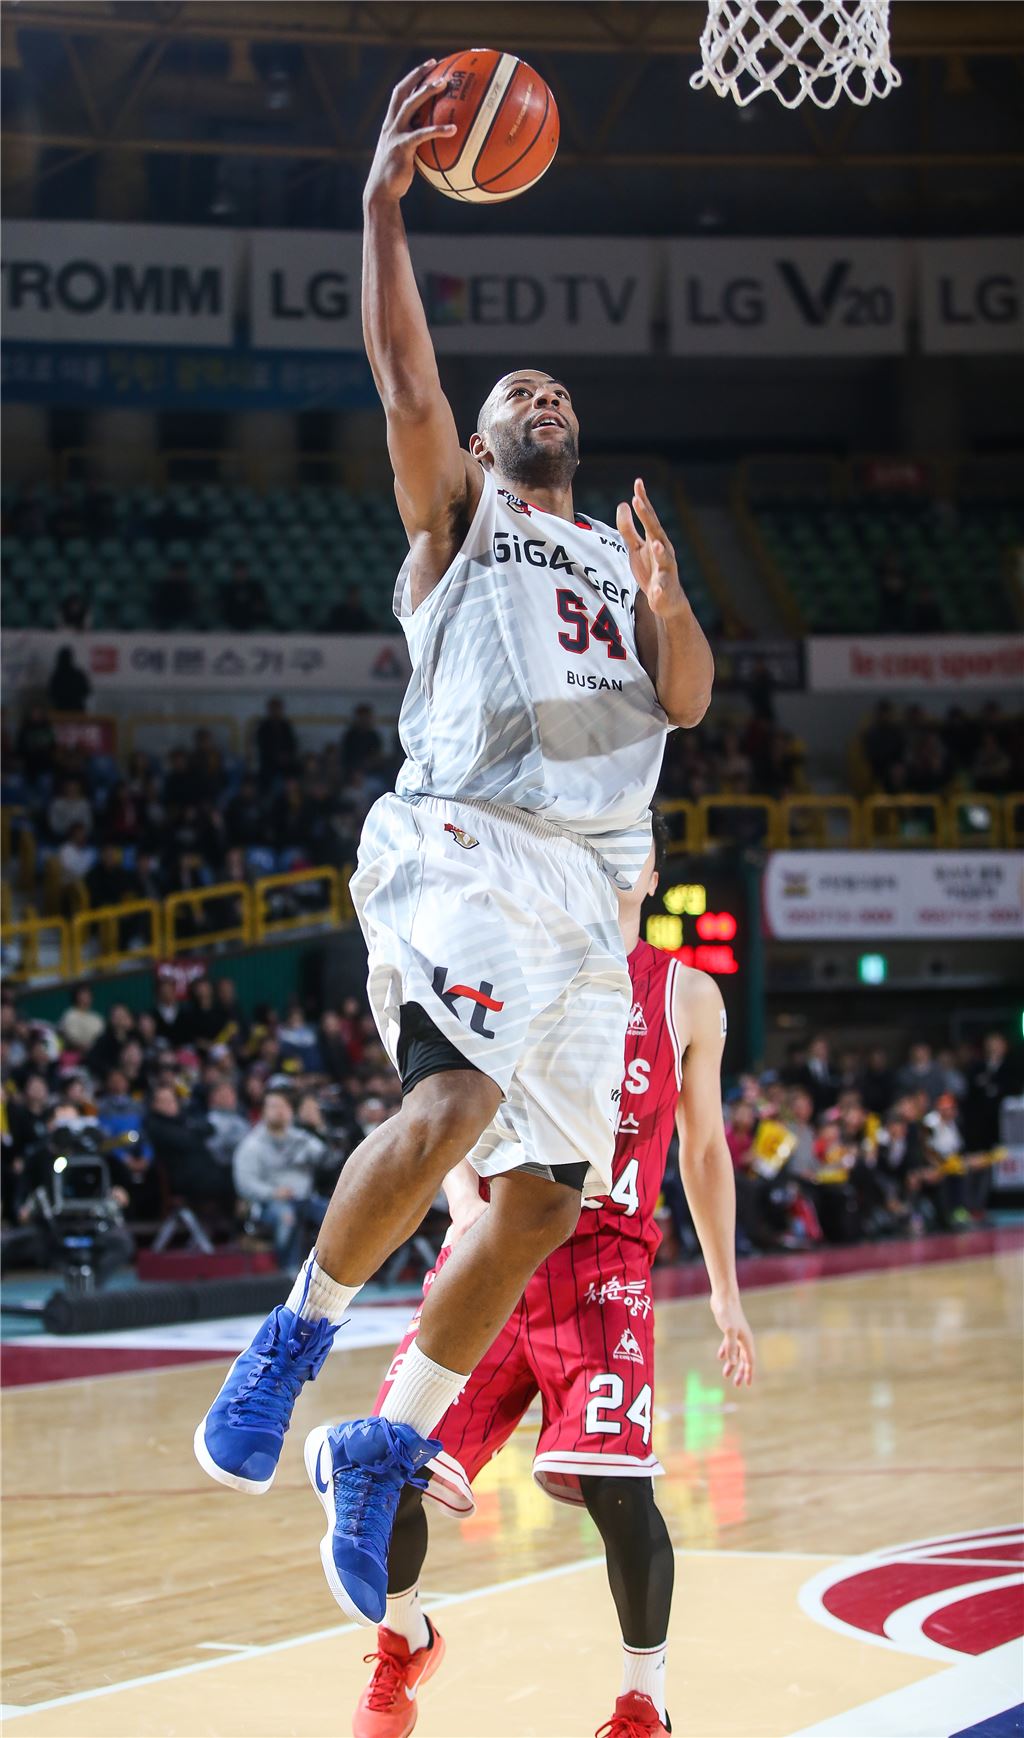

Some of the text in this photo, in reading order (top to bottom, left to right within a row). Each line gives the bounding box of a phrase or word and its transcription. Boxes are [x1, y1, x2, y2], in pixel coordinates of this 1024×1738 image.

[0, 260, 222, 316] ROMM
[269, 270, 350, 321] LG
[550, 274, 637, 326] TV
[685, 259, 894, 327] LG V20
[938, 275, 1018, 326] LG
[493, 532, 577, 575] GiGA
[555, 588, 627, 661] 54
[566, 670, 623, 692] BUSAN
[585, 1373, 652, 1446] 24
